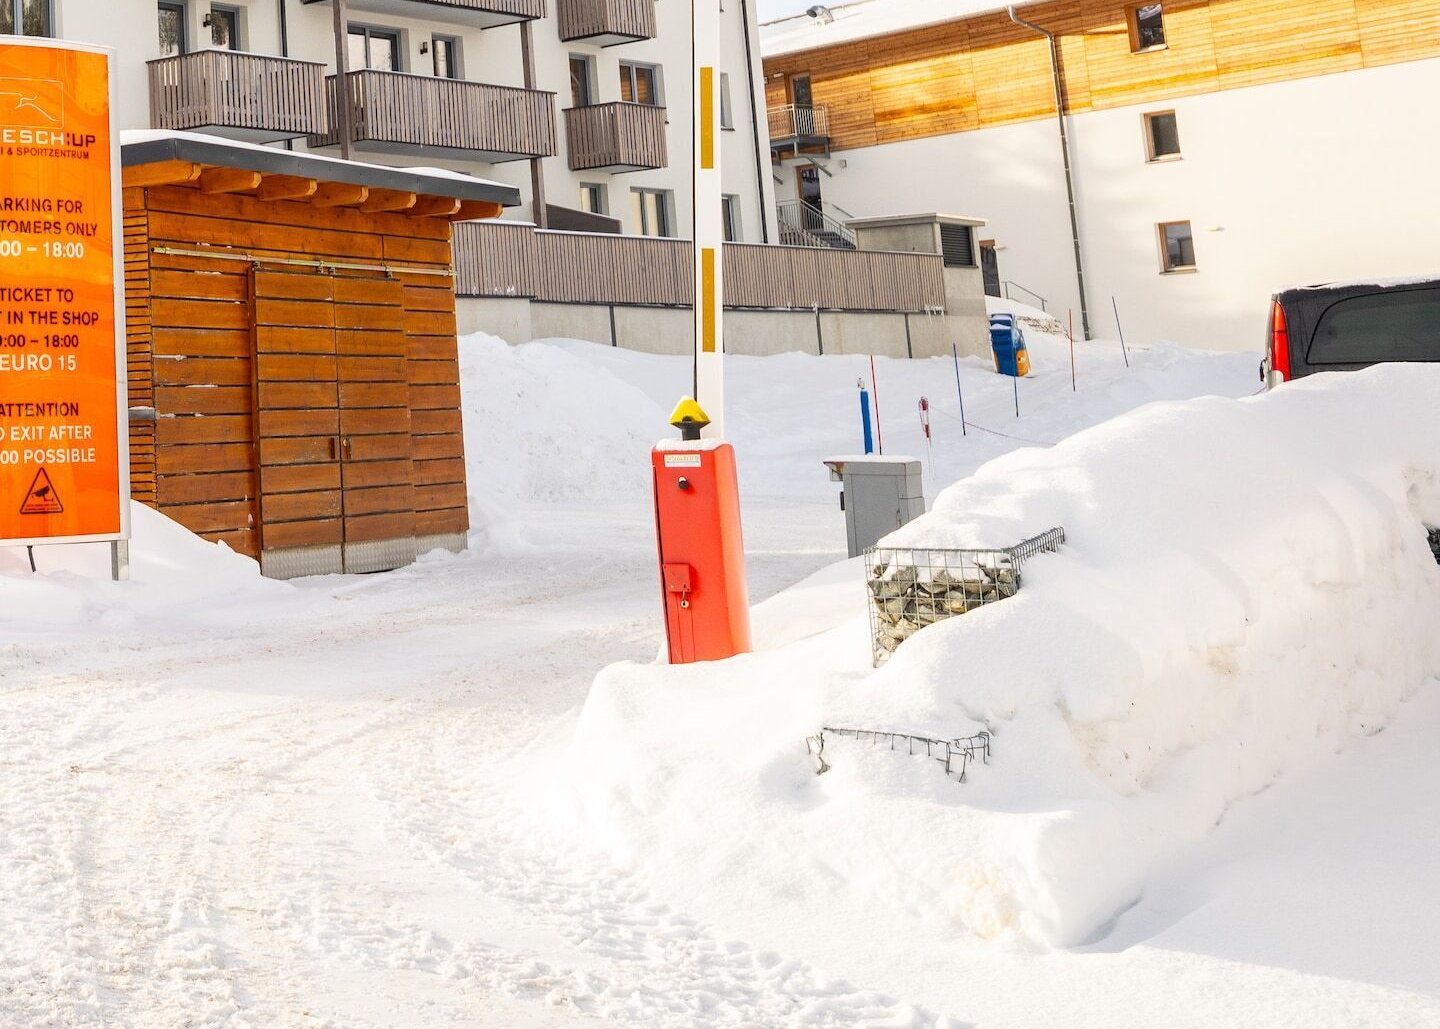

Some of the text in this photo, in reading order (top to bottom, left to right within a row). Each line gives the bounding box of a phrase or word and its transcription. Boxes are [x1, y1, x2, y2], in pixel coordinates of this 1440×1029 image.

[7, 147, 13, 156] &
[16, 147, 89, 159] SPORTZENTRUM
[57, 199, 82, 213] FOR
[66, 222, 97, 236] ONLY
[43, 241, 84, 258] 18:00
[56, 288, 74, 302] TO
[7, 311, 23, 325] IN
[28, 311, 57, 325] THE
[62, 311, 99, 326] SHOP
[44, 334, 79, 348] 18:00
[59, 355, 76, 371] 15
[10, 426, 45, 441] EXIT
[49, 425, 92, 440] AFTER
[24, 448, 96, 464] POSSIBLE
